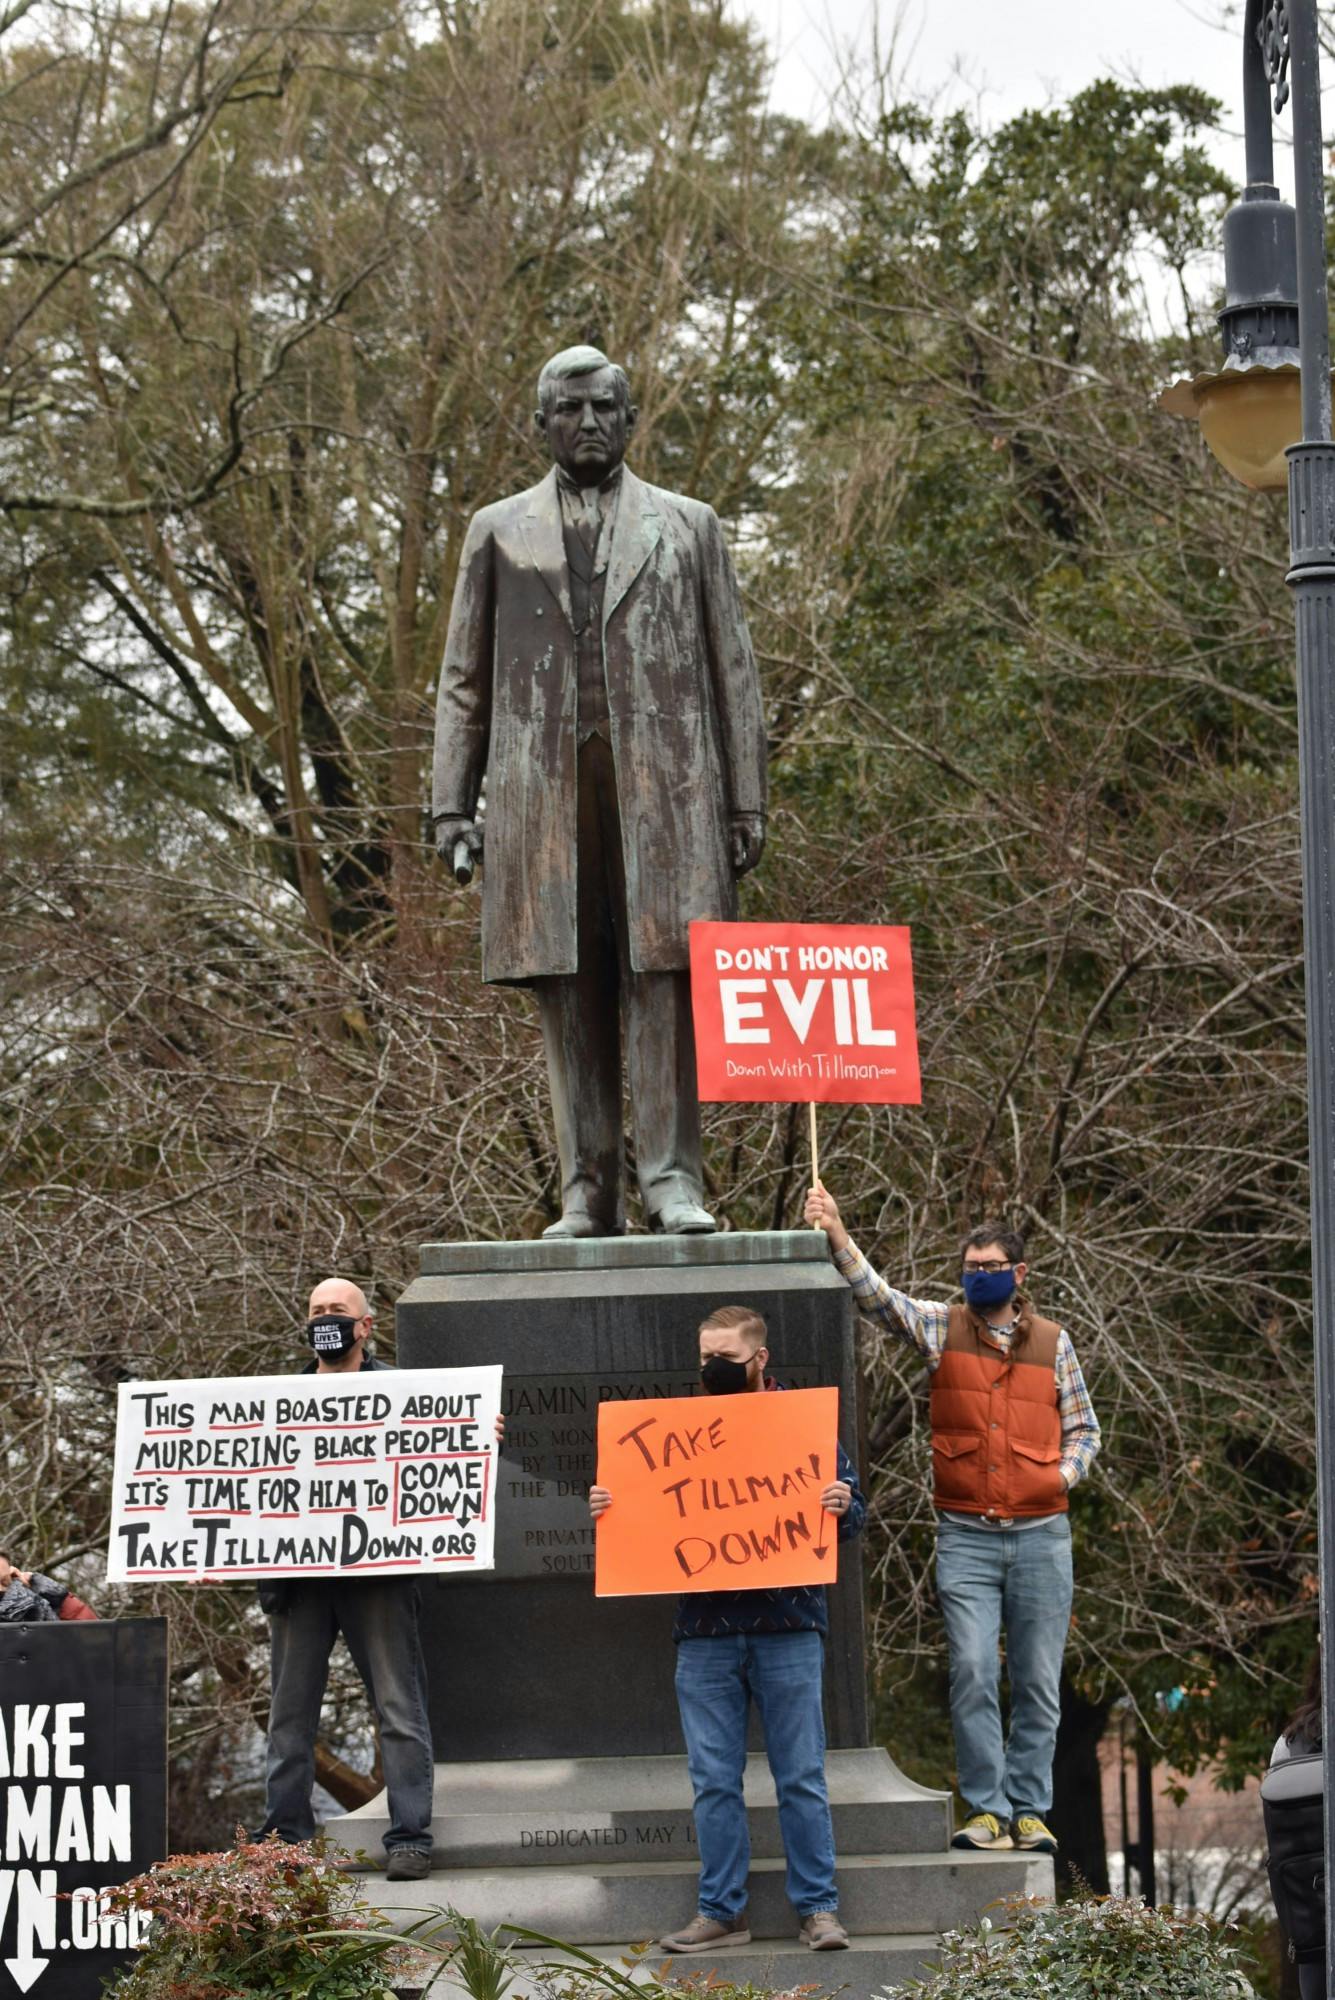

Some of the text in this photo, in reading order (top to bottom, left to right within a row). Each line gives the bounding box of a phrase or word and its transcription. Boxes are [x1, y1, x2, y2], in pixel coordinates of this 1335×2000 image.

[715, 945, 889, 971] DON'T HONOR
[719, 978, 896, 1046] EVIL
[313, 1324, 340, 1332] BLACK
[316, 1333, 339, 1342] LIVES
[314, 1342, 343, 1350] MATTER
[131, 1392, 482, 1429] THIS MAN BOASTED ABOUT
[135, 1424, 491, 1470] MURDERING BLACK PEOPLE.
[505, 1431, 539, 1448] HIS
[617, 1417, 727, 1472] TAKE
[400, 1462, 482, 1490] COME
[522, 1454, 592, 1473] BY THE
[124, 1477, 389, 1514] IT'S TIME FOR HIM TO
[508, 1481, 546, 1498] THE
[662, 1453, 821, 1518] TILLMAN
[400, 1491, 482, 1519] DOWN
[0, 1784, 131, 1862] MAN
[520, 1827, 627, 1848] DEDICATED
[636, 1826, 675, 1843] MAY
